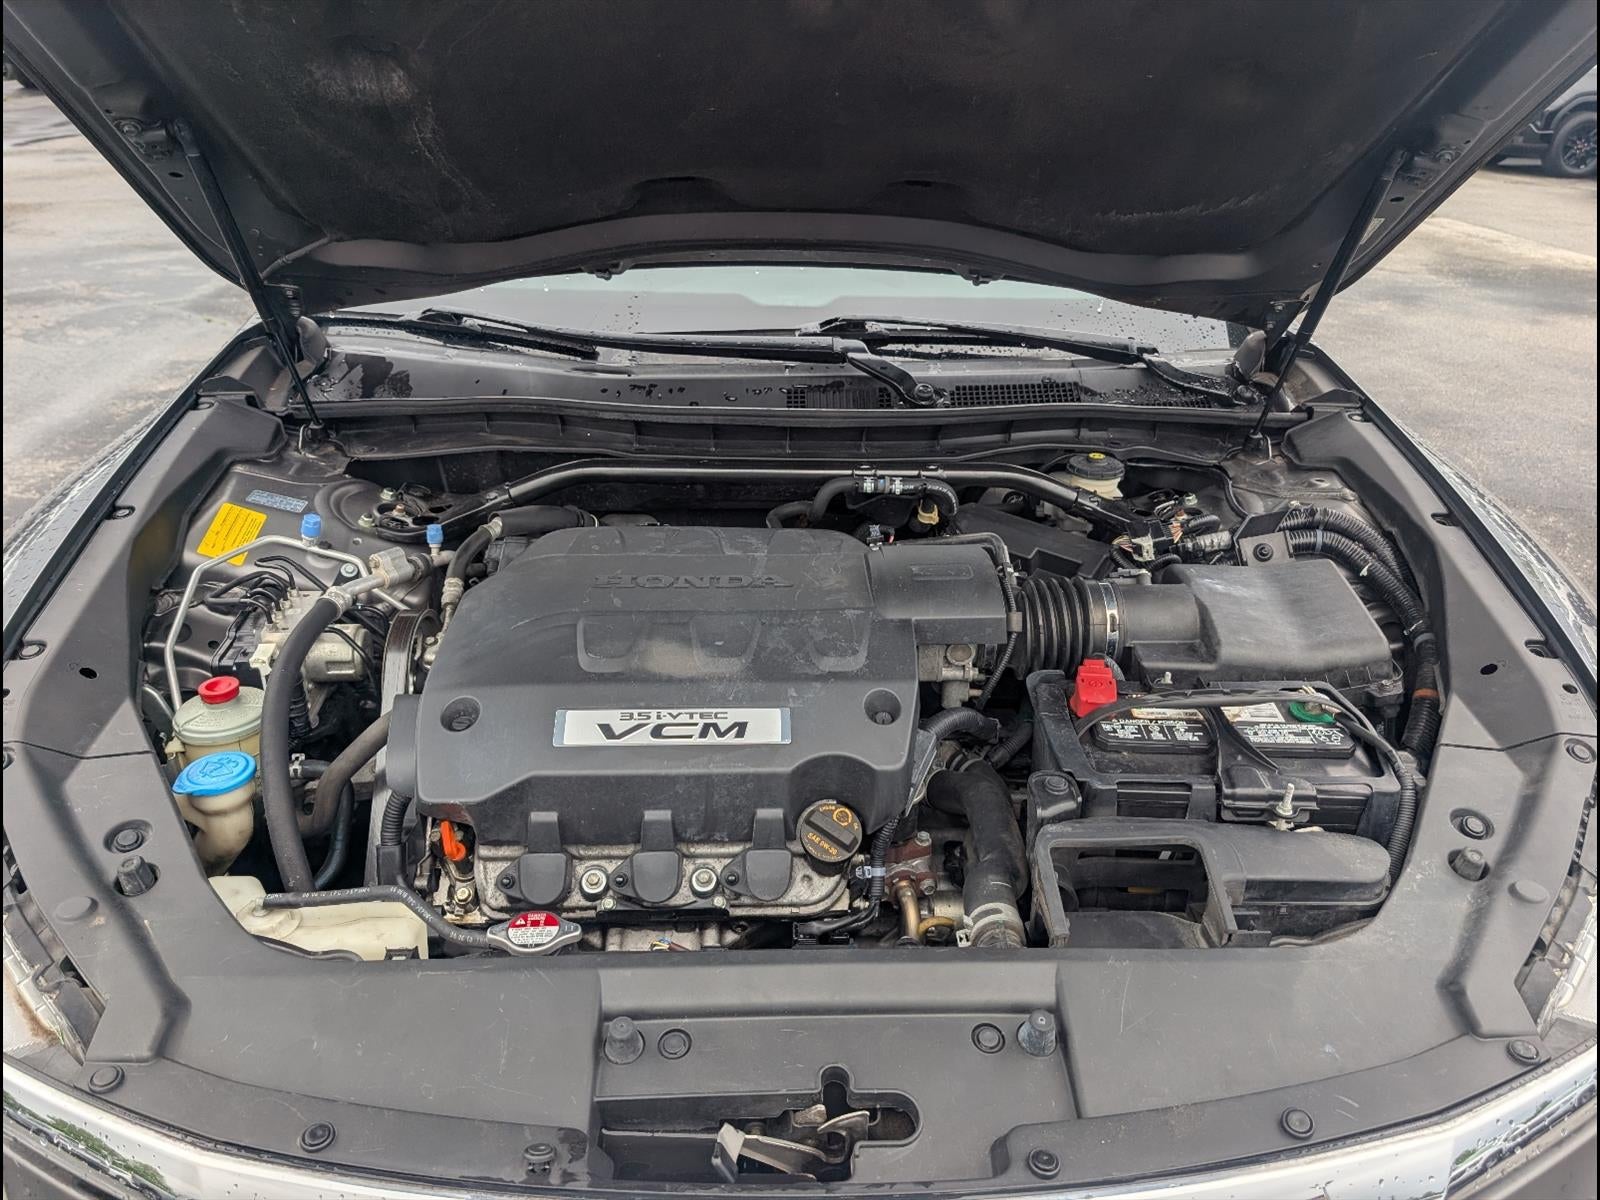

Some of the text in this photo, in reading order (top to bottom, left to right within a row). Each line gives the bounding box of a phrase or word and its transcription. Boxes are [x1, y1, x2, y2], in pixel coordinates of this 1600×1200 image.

[592, 575, 794, 588] HONDA
[619, 711, 729, 721] 3.5 i-VTEC
[597, 721, 749, 741] VCM
